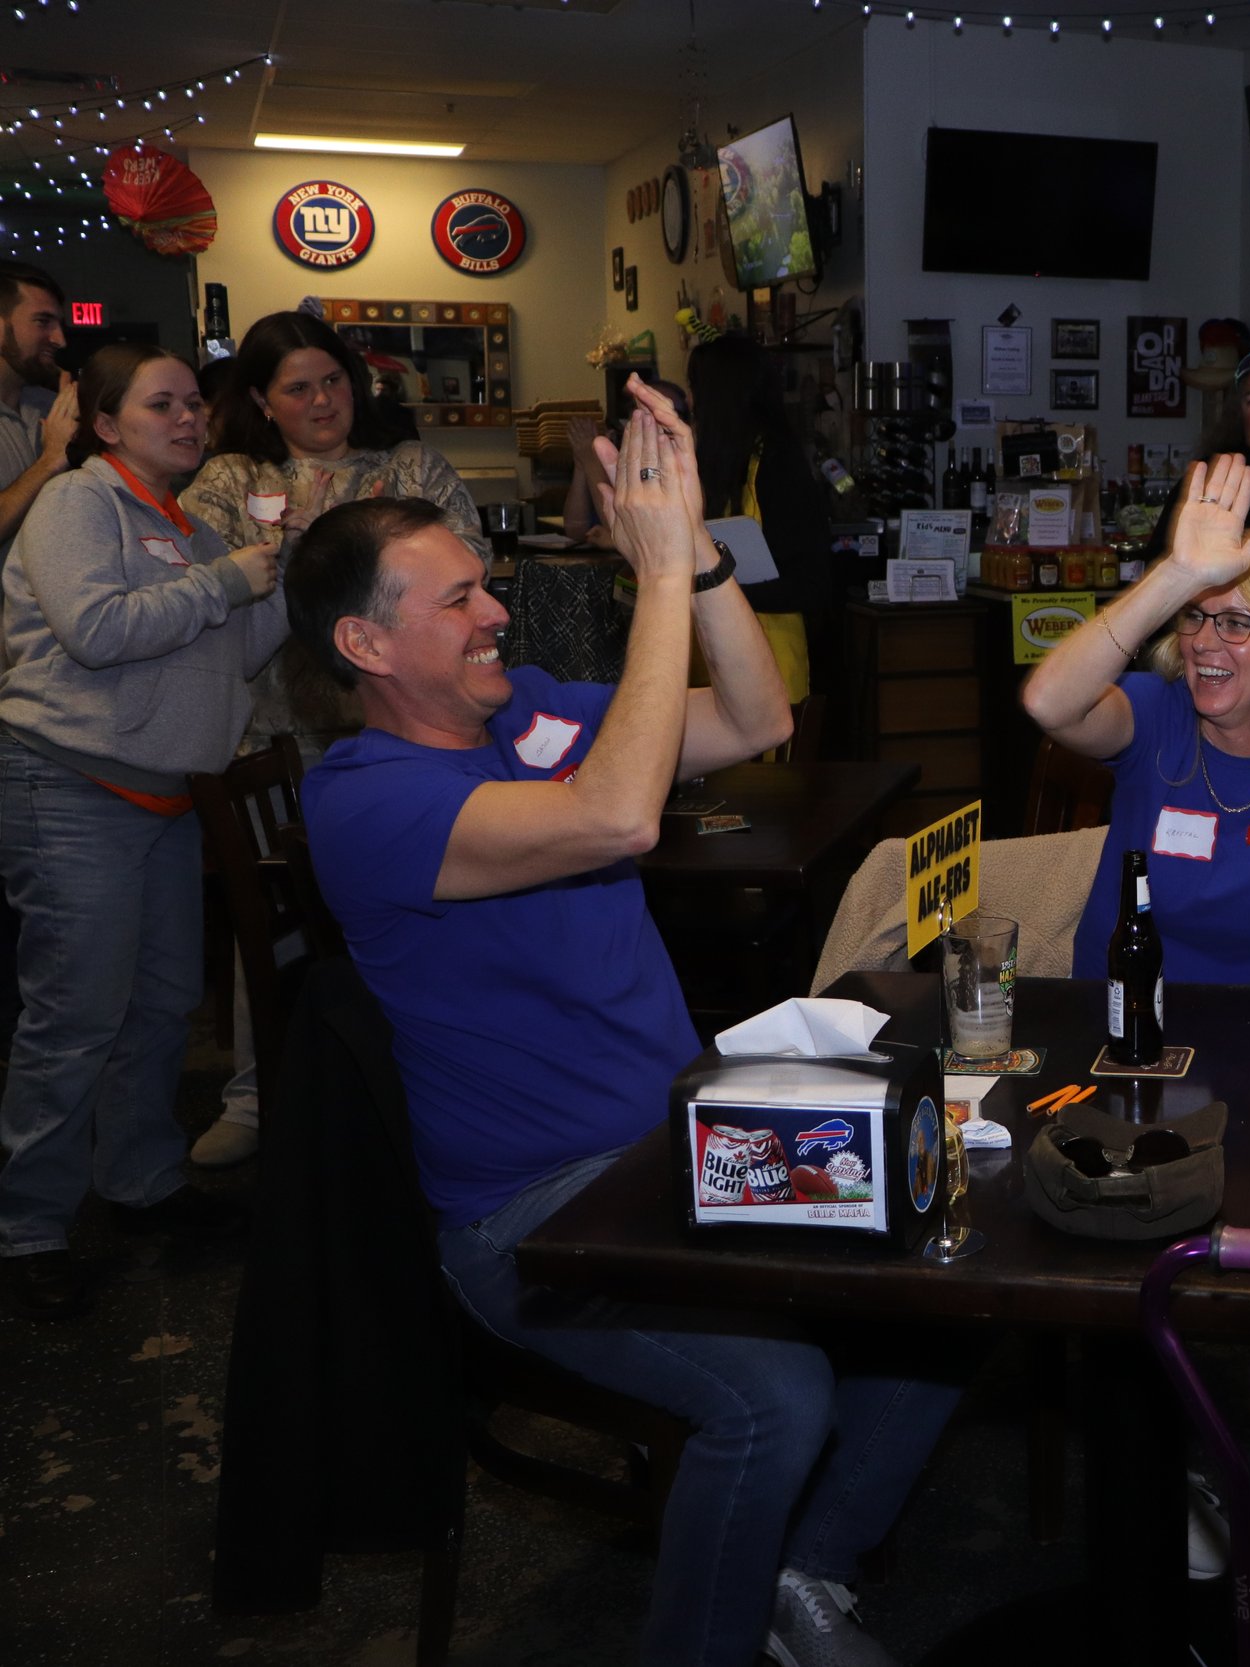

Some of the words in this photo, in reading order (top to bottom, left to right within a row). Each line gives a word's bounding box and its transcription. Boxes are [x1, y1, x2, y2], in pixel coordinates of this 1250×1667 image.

[288, 183, 320, 206] NEW
[325, 184, 365, 212] YORK
[451, 192, 511, 215] BUFFALO
[299, 247, 357, 266] GIANTS
[459, 257, 500, 271] BILLS
[72, 302, 103, 325] EXIT
[933, 525, 953, 534] MENU
[1032, 596, 1058, 604] Proudly
[1060, 596, 1087, 604] Support
[910, 807, 979, 878] ALPHABET
[918, 856, 970, 923] ALE-ERS
[705, 1150, 748, 1179] Blue
[825, 1161, 870, 1181] Serving!
[841, 1155, 856, 1166] Now
[702, 1173, 744, 1194] LIGHT
[749, 1166, 788, 1188] Blue
[808, 1208, 836, 1218] BILLS
[838, 1208, 871, 1218] MAFIA
[1235, 1573, 1250, 1620] vive
